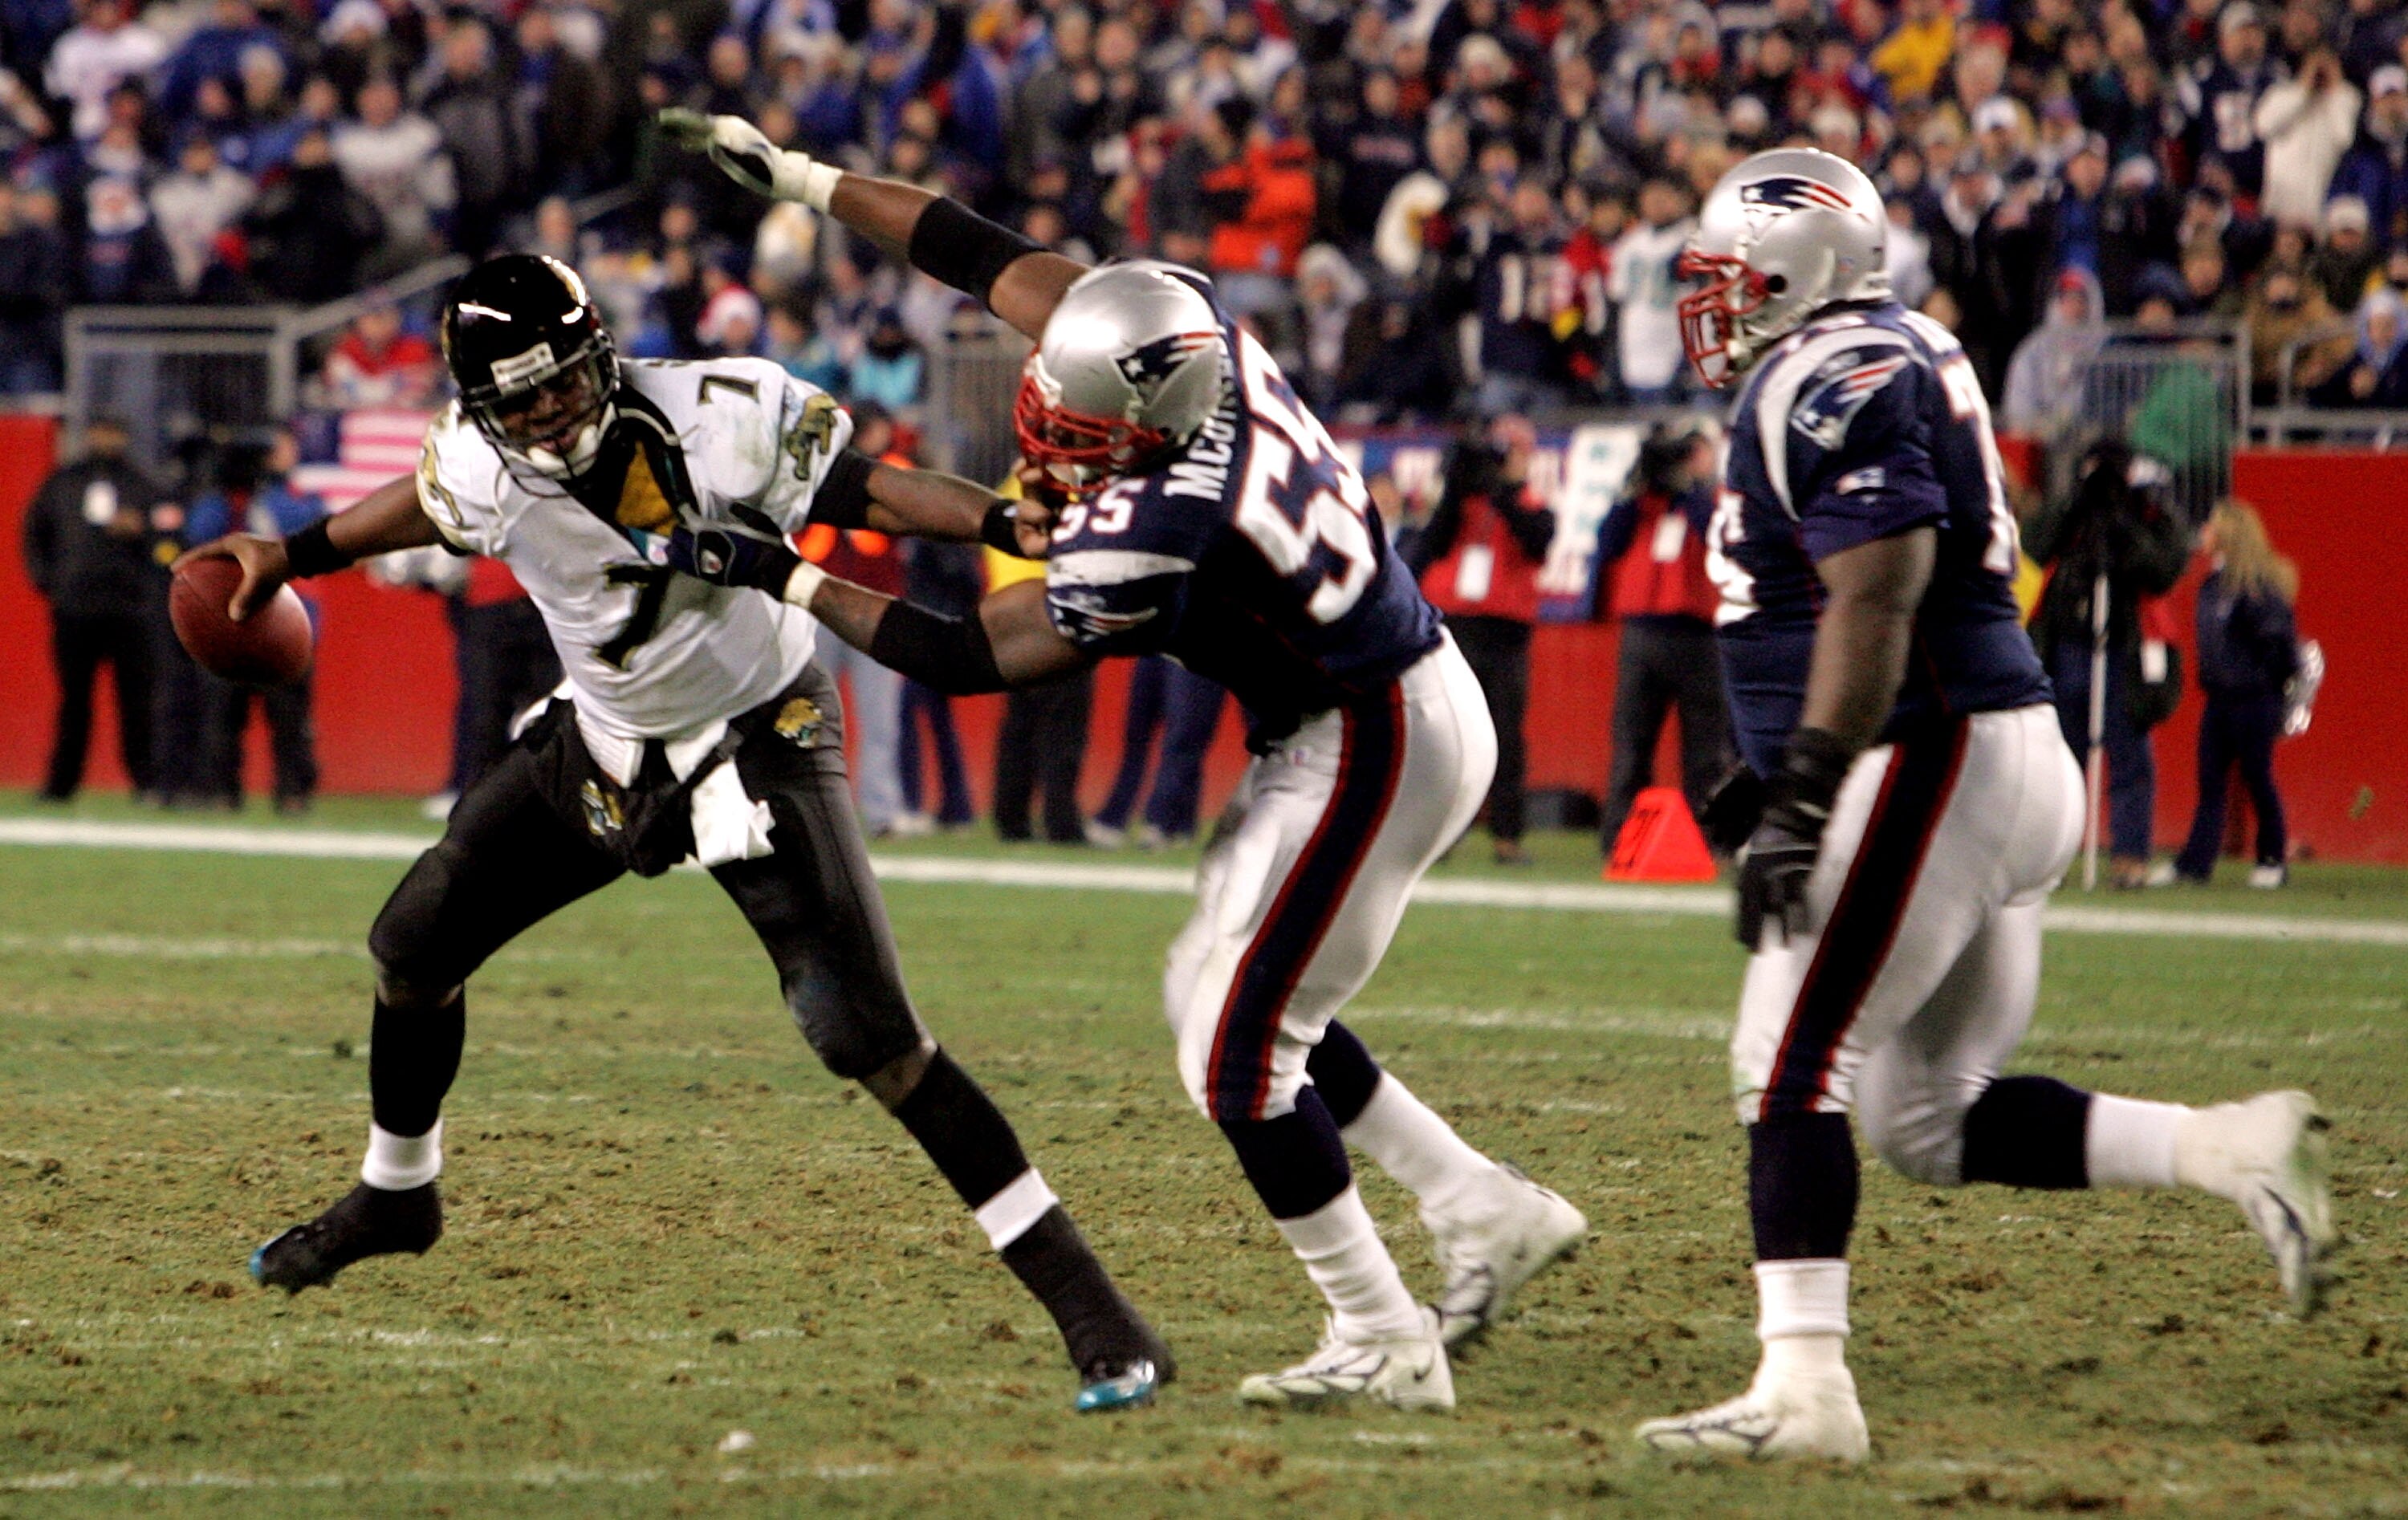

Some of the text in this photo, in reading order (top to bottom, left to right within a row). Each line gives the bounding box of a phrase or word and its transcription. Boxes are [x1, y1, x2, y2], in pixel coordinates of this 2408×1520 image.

[697, 373, 760, 405] 7
[1235, 325, 1378, 625] 55
[591, 562, 677, 672] 7
